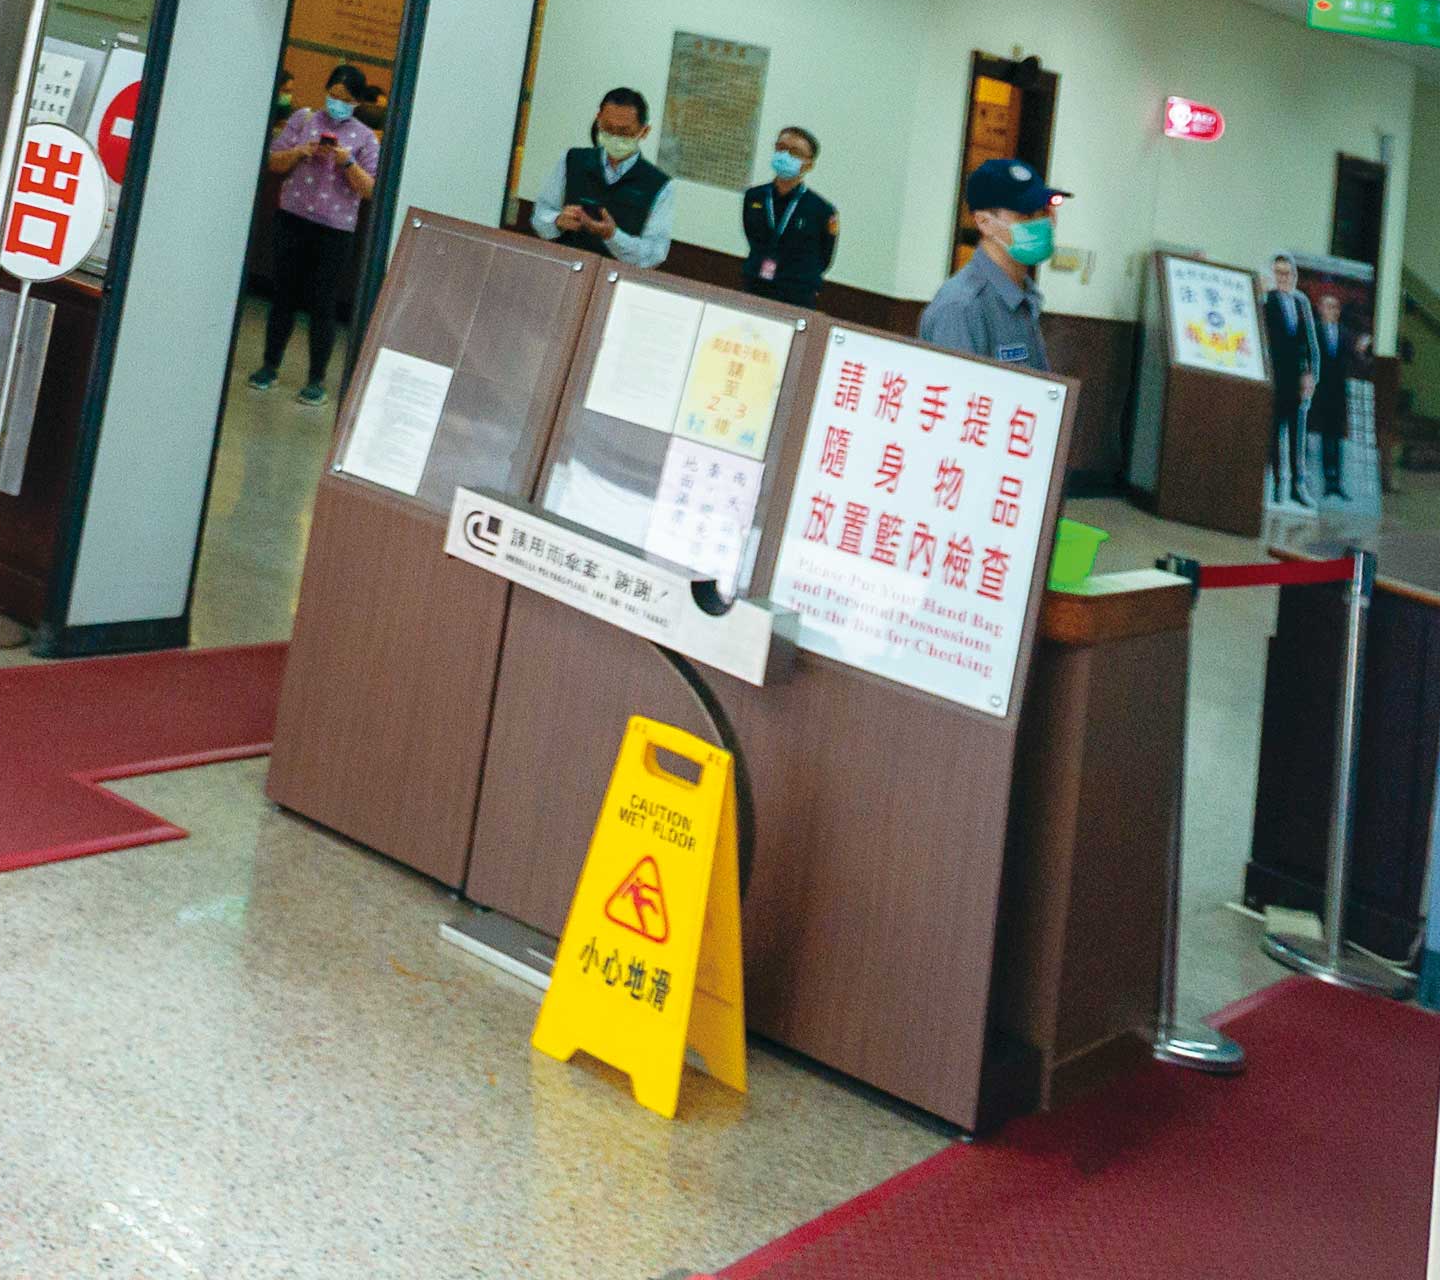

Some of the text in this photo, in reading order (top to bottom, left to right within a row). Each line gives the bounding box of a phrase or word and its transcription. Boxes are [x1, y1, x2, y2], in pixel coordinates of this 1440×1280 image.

[4, 140, 84, 267] 出口
[834, 361, 1036, 460] 請將手提包
[819, 425, 1024, 528] 隨身物品
[802, 492, 1011, 602] 放置籃內檢查
[792, 580, 992, 654] and Personal Possessions
[886, 628, 910, 647] for
[913, 638, 994, 679] Checking
[921, 597, 967, 623] Hand
[970, 613, 1004, 637] Bag
[619, 807, 697, 853] WET FLOOR
[630, 793, 692, 833] CAUTION
[579, 936, 672, 1013] 小心地滑
